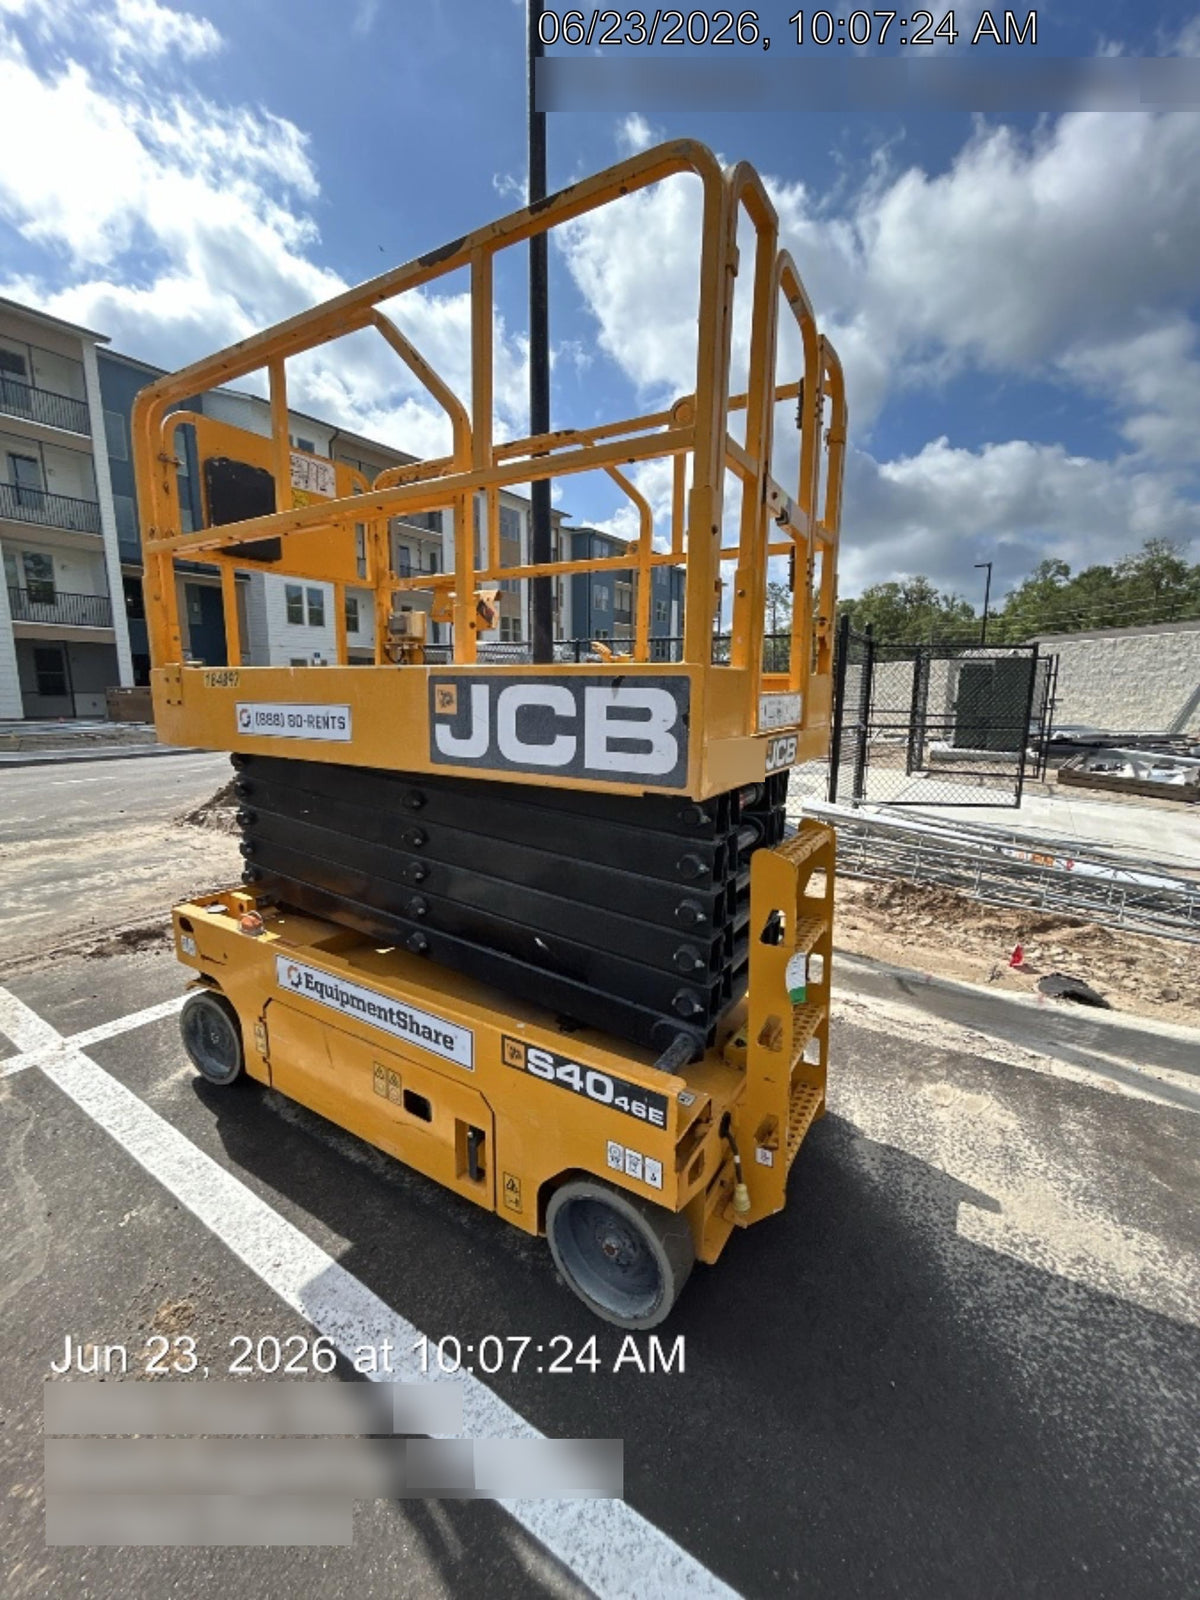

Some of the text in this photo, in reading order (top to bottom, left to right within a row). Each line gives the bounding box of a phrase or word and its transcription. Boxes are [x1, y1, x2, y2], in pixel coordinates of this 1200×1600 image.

[255, 711, 346, 730] (888) 80-RENTS
[434, 683, 679, 776] JCB
[765, 737, 797, 770] JCB
[303, 972, 455, 1051] EquipmentShare
